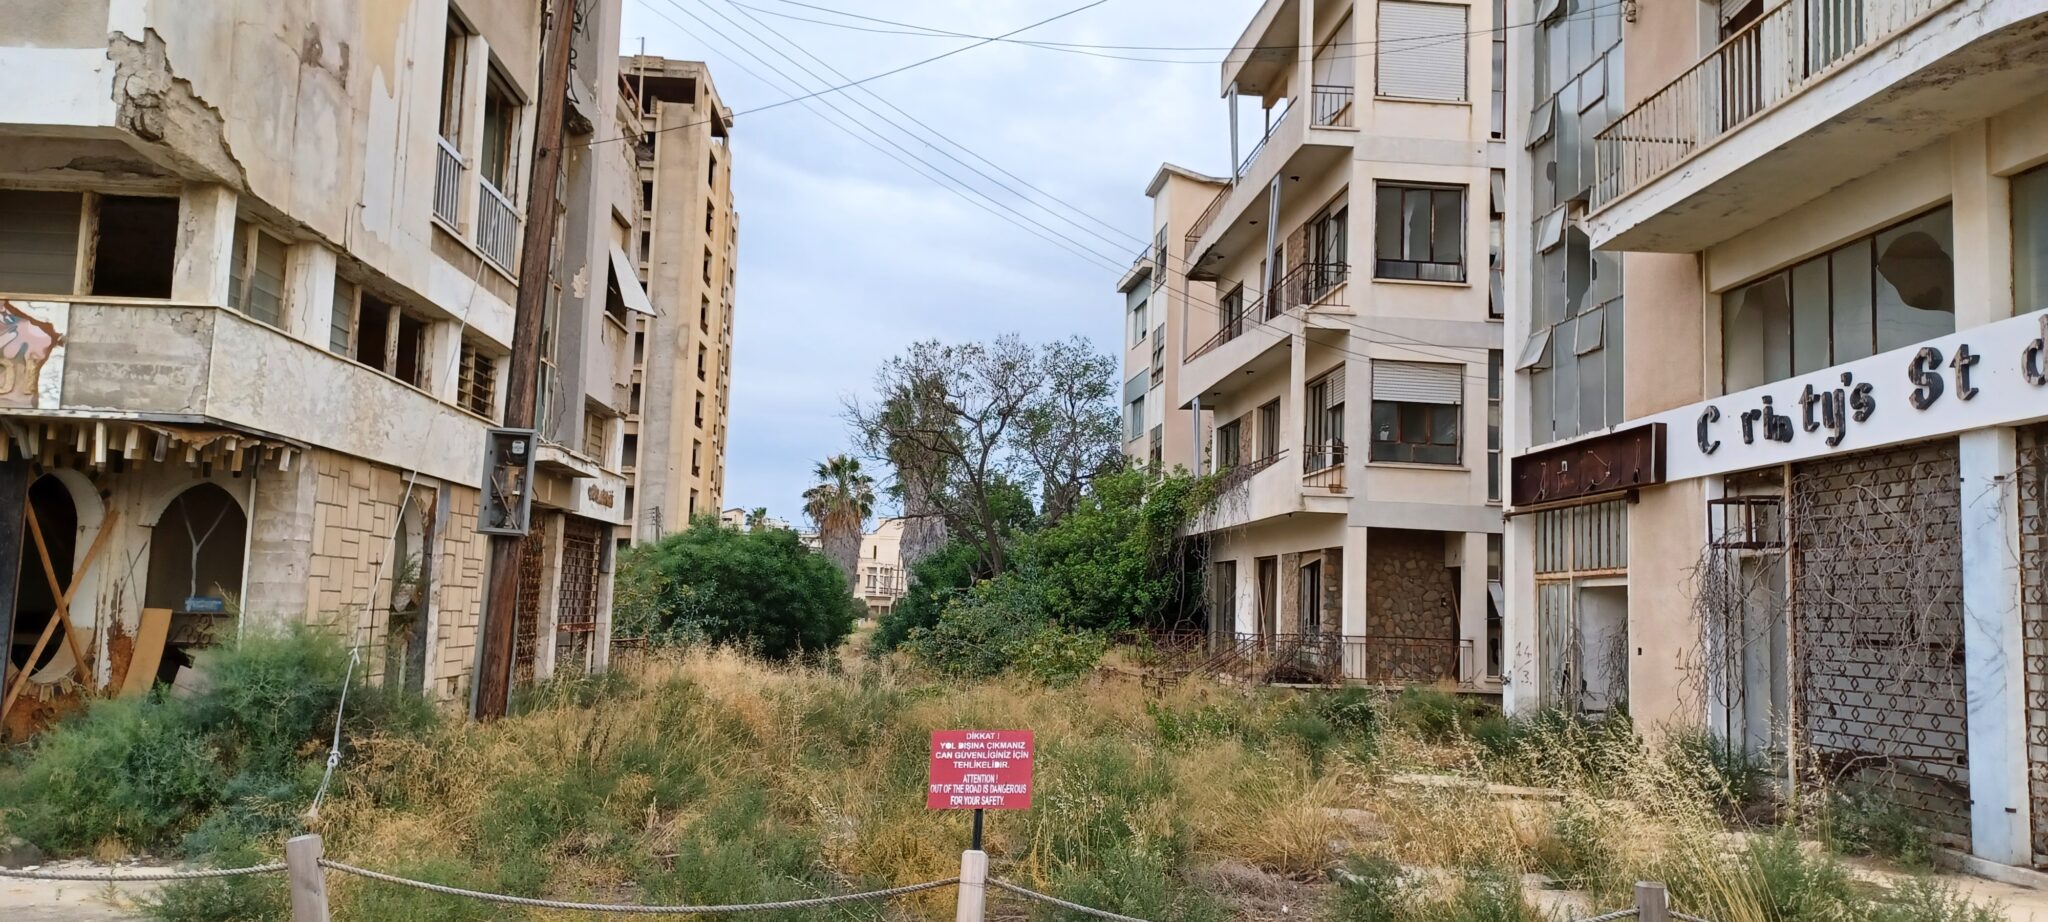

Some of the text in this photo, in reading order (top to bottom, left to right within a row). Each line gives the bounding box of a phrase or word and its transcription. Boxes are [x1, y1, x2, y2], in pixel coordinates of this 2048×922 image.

[966, 732, 995, 740] DİKKAT
[940, 742, 956, 750] YOL
[935, 751, 952, 759] CAN
[962, 774, 995, 783] ATTENTION
[930, 784, 1027, 794] OUT OF THE ROAD IS DANGEROUS
[950, 796, 1005, 806] FOR YOUR SAFETY.
